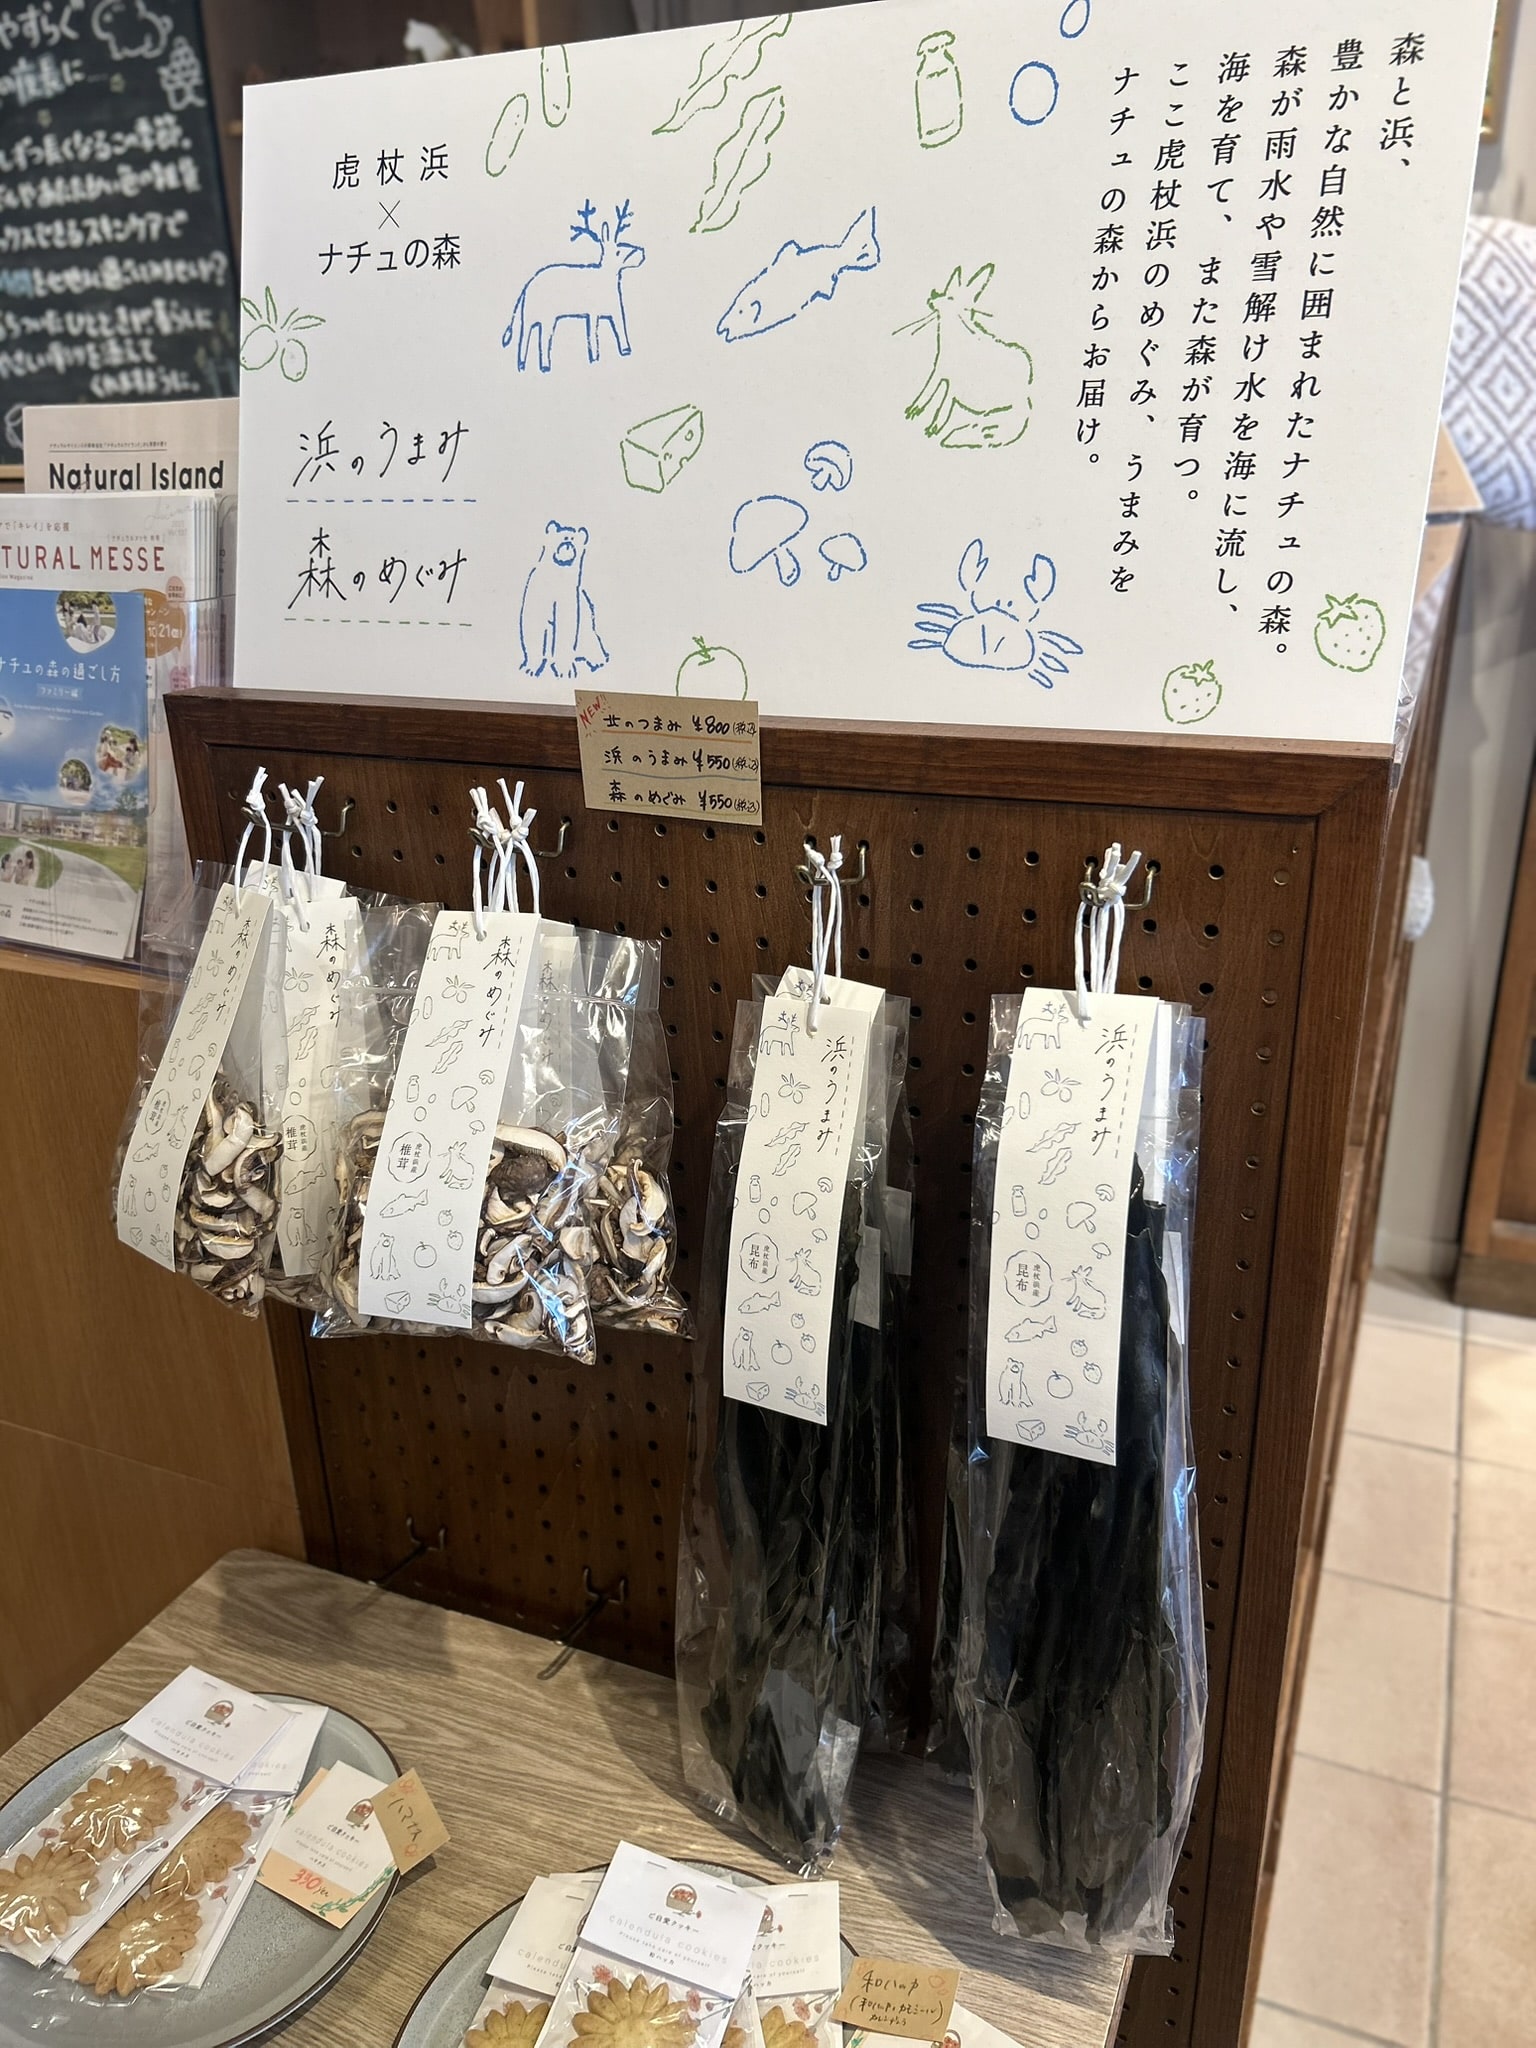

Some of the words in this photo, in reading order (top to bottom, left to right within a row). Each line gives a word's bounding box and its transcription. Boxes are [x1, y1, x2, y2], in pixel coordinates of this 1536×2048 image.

[1379, 31, 1425, 167] 森と浜、
[331, 143, 449, 190] 虎杖浜
[318, 233, 462, 275] ナチュの森
[1076, 66, 1140, 464] ナチュの森からお届け。
[1174, 51, 1250, 501] 海を育て、また森が育つ。
[1110, 62, 1189, 593] ここ虎杖浜のめぐみ、うまみを
[1214, 44, 1308, 613] 森が雨水や雪解け水を海に流し、
[1258, 38, 1364, 655] 豊かな自然に囲まれたナチュの森。
[49, 462, 141, 490] Natural
[151, 460, 224, 490] Island
[292, 420, 470, 487] 浜のうまみ
[1, 545, 81, 570] TURAL
[90, 546, 165, 572] MESSE
[288, 527, 468, 610] 森のめぐみ
[604, 746, 688, 767] 浜のうまみ
[608, 779, 687, 805] 森のめぐみ
[215, 916, 252, 1022] 森のめぐみ
[316, 922, 346, 1028] 森のめぐみ
[479, 935, 515, 1048] 森のめぐみ
[816, 1034, 848, 1153] 浜のうまみ
[1090, 1026, 1129, 1157] 浜のうまみ
[285, 1126, 298, 1151] 椎茸
[396, 1143, 412, 1170] 椎茸
[748, 1243, 760, 1270] 昆布
[1015, 1263, 1030, 1292] 昆布
[608, 1914, 672, 1945] calendula
[677, 1941, 728, 1965] cookies
[769, 1954, 820, 1968] cookies
